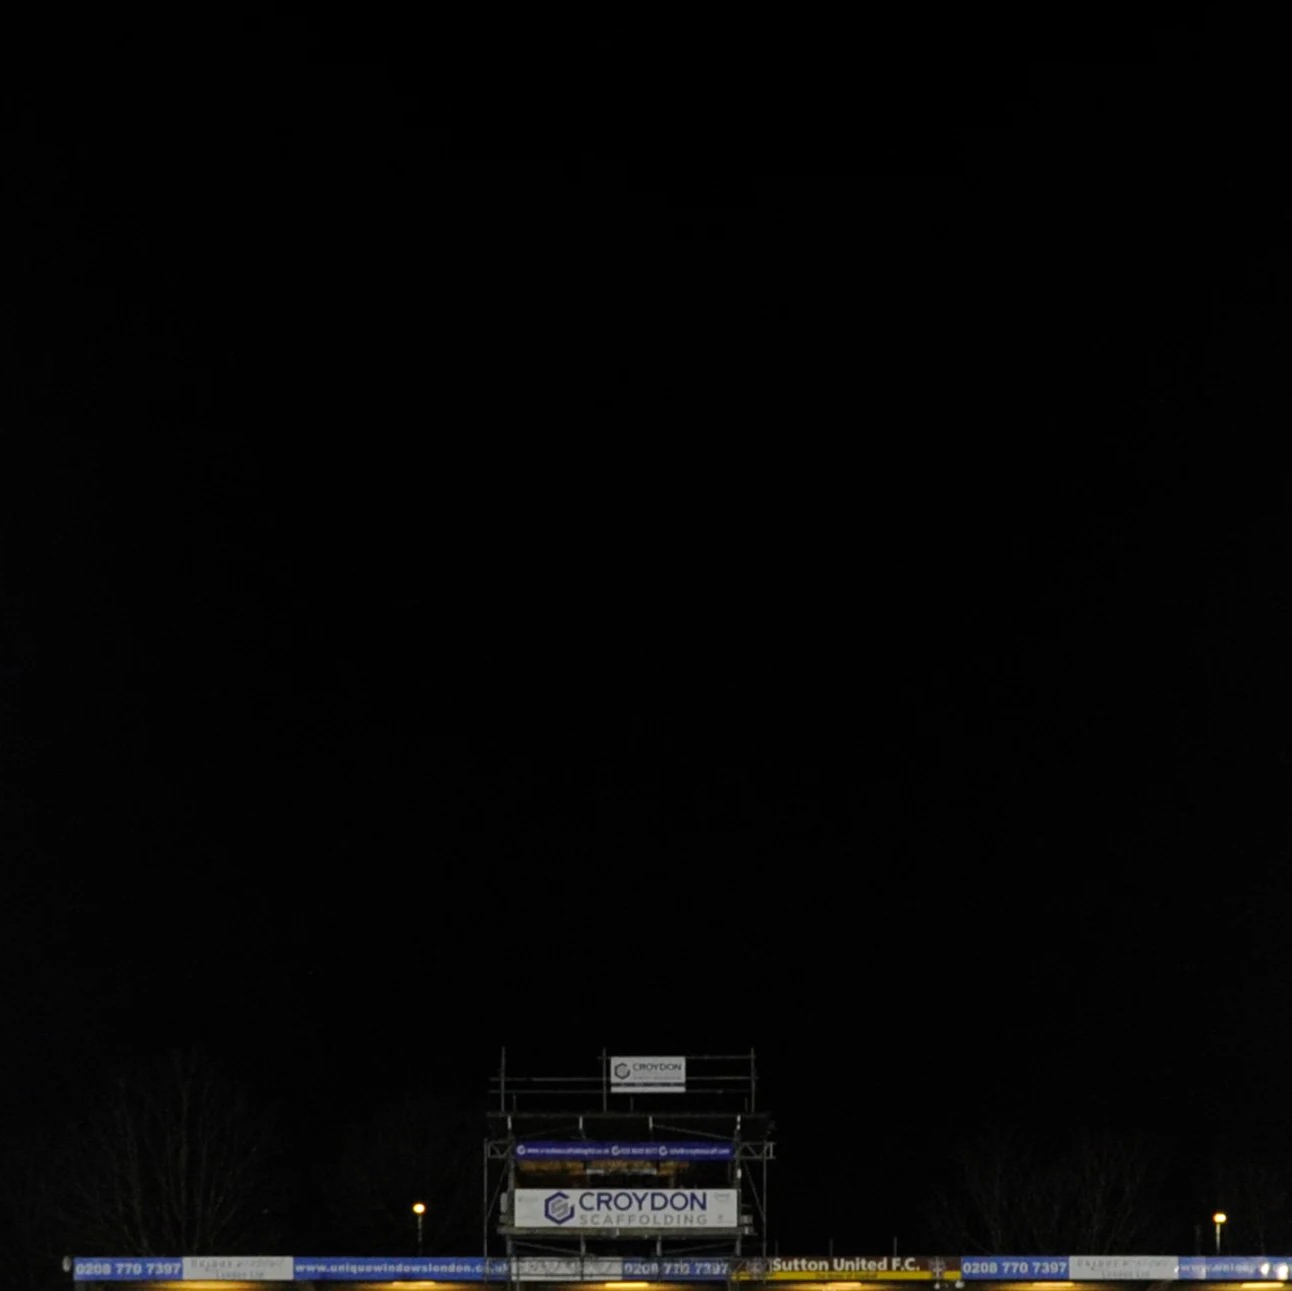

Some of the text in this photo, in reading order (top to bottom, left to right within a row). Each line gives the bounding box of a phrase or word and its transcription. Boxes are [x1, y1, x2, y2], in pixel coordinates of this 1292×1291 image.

[632, 1063, 682, 1072] CROYDON
[578, 1191, 708, 1211] CROYDON
[579, 1213, 708, 1225] SCAFFOLDING
[772, 1258, 920, 1271] Sutton United F.C.
[963, 1263, 997, 1275] 0208
[1002, 1263, 1028, 1275] 770
[1032, 1263, 1066, 1275] 7397
